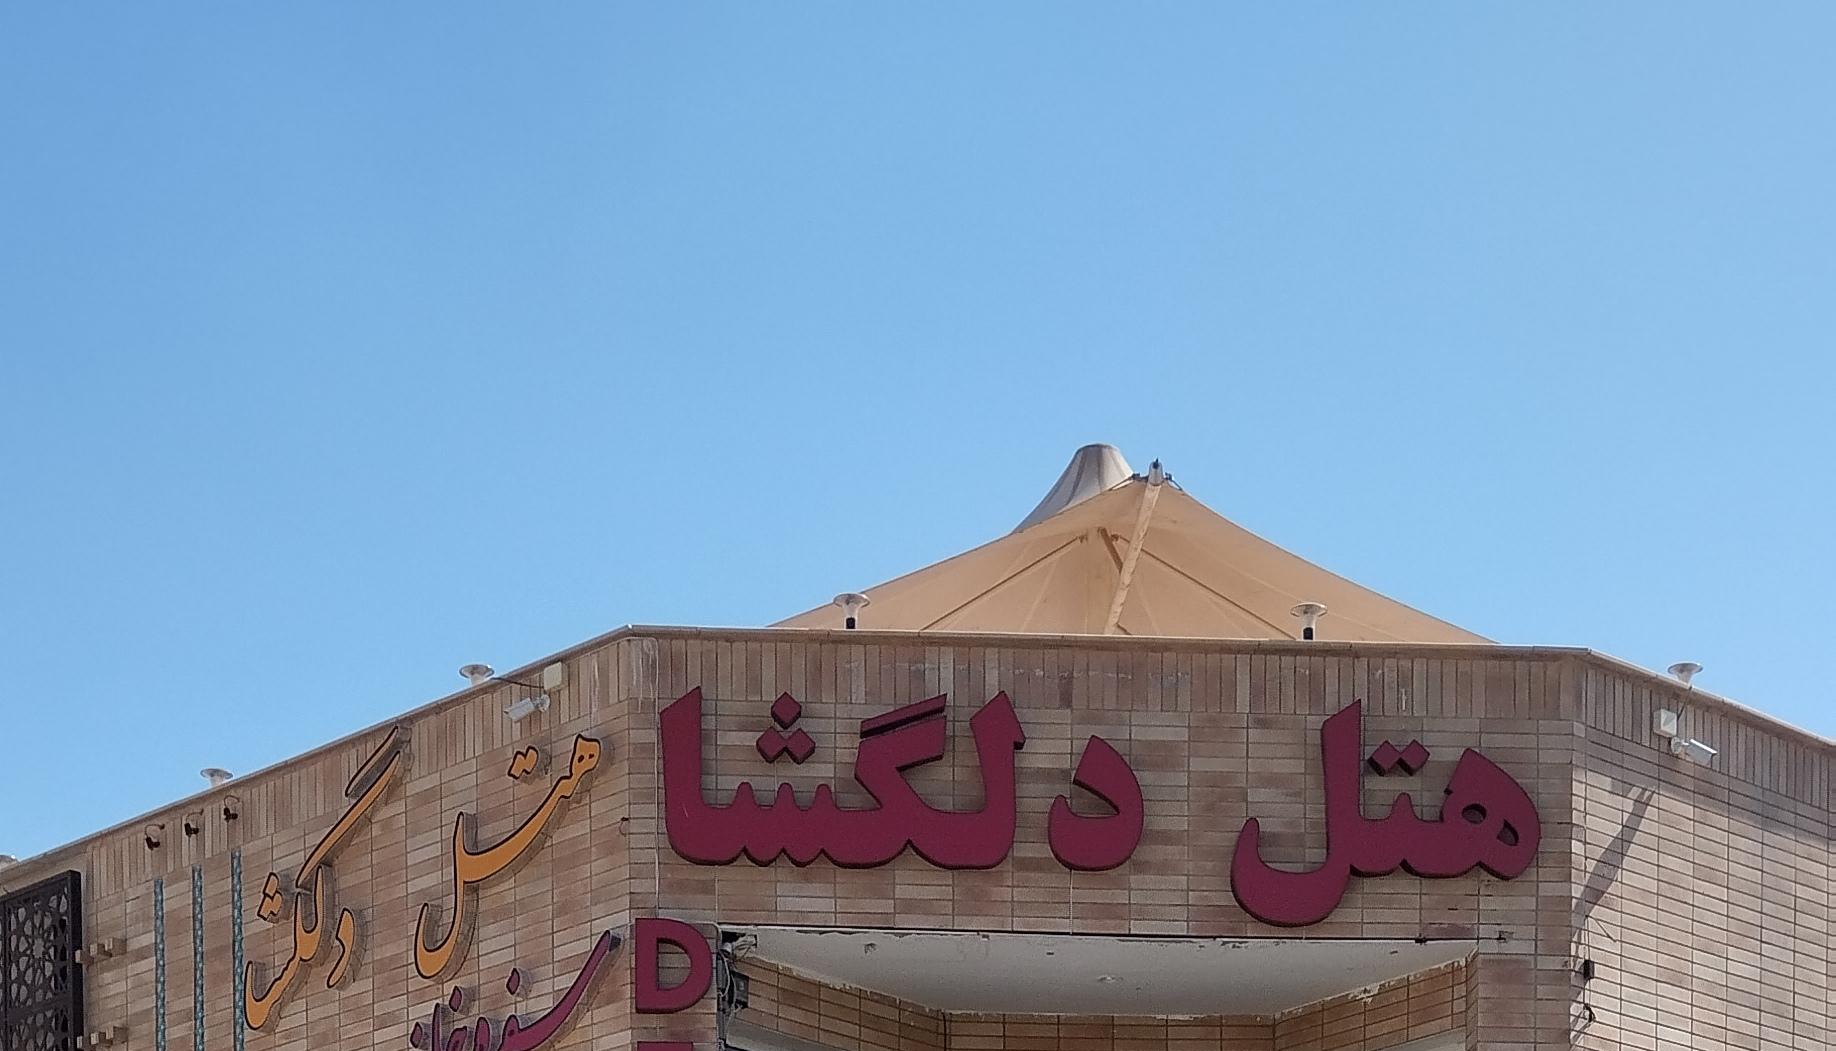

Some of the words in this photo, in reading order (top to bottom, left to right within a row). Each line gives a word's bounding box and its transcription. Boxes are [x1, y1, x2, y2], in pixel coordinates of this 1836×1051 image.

[414, 734, 603, 979] هتل
[659, 685, 1144, 871] دلگشا
[1231, 698, 1541, 928] هتل
